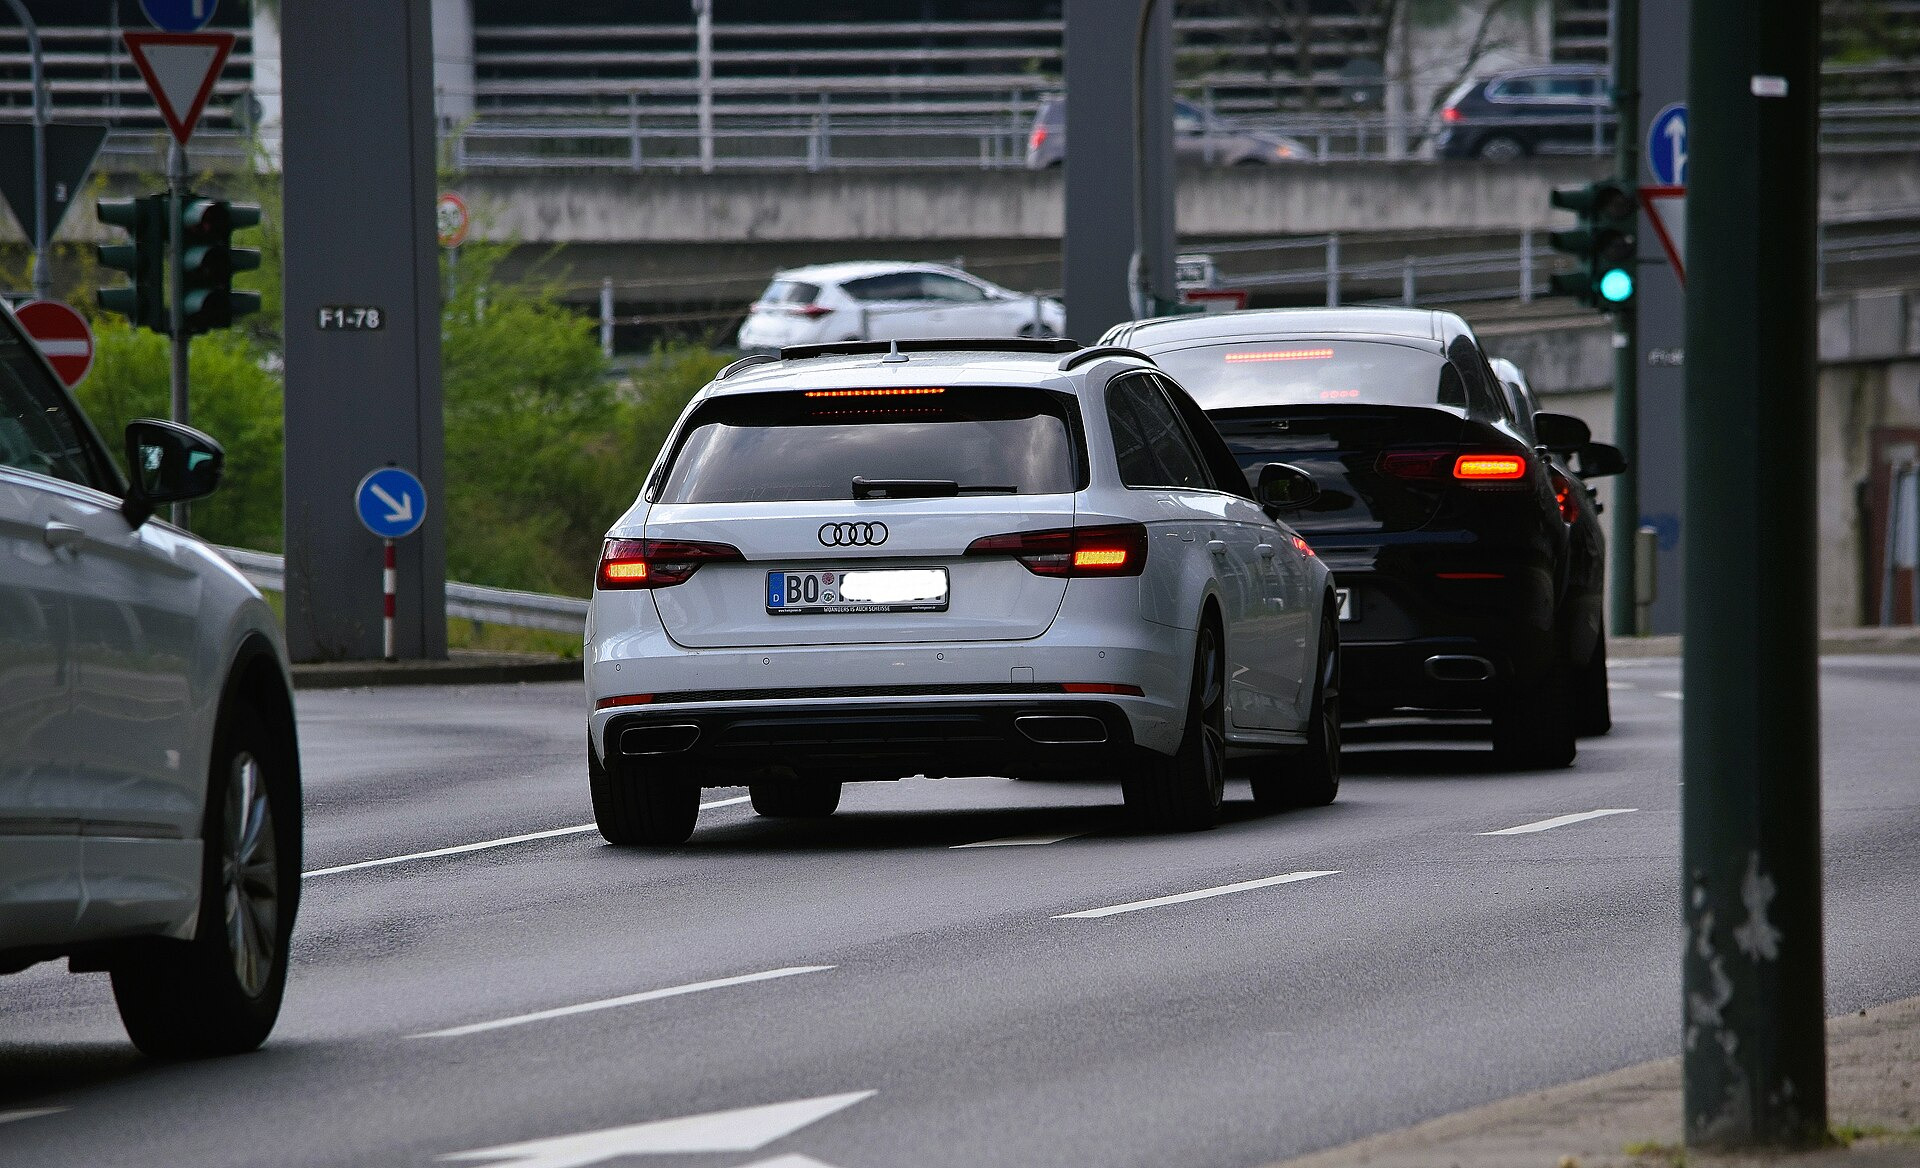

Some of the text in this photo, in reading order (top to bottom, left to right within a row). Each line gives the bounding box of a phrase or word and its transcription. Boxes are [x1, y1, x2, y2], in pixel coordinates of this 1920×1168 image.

[320, 308, 380, 329] F1-78
[773, 593, 780, 603] D
[786, 574, 819, 604] BO
